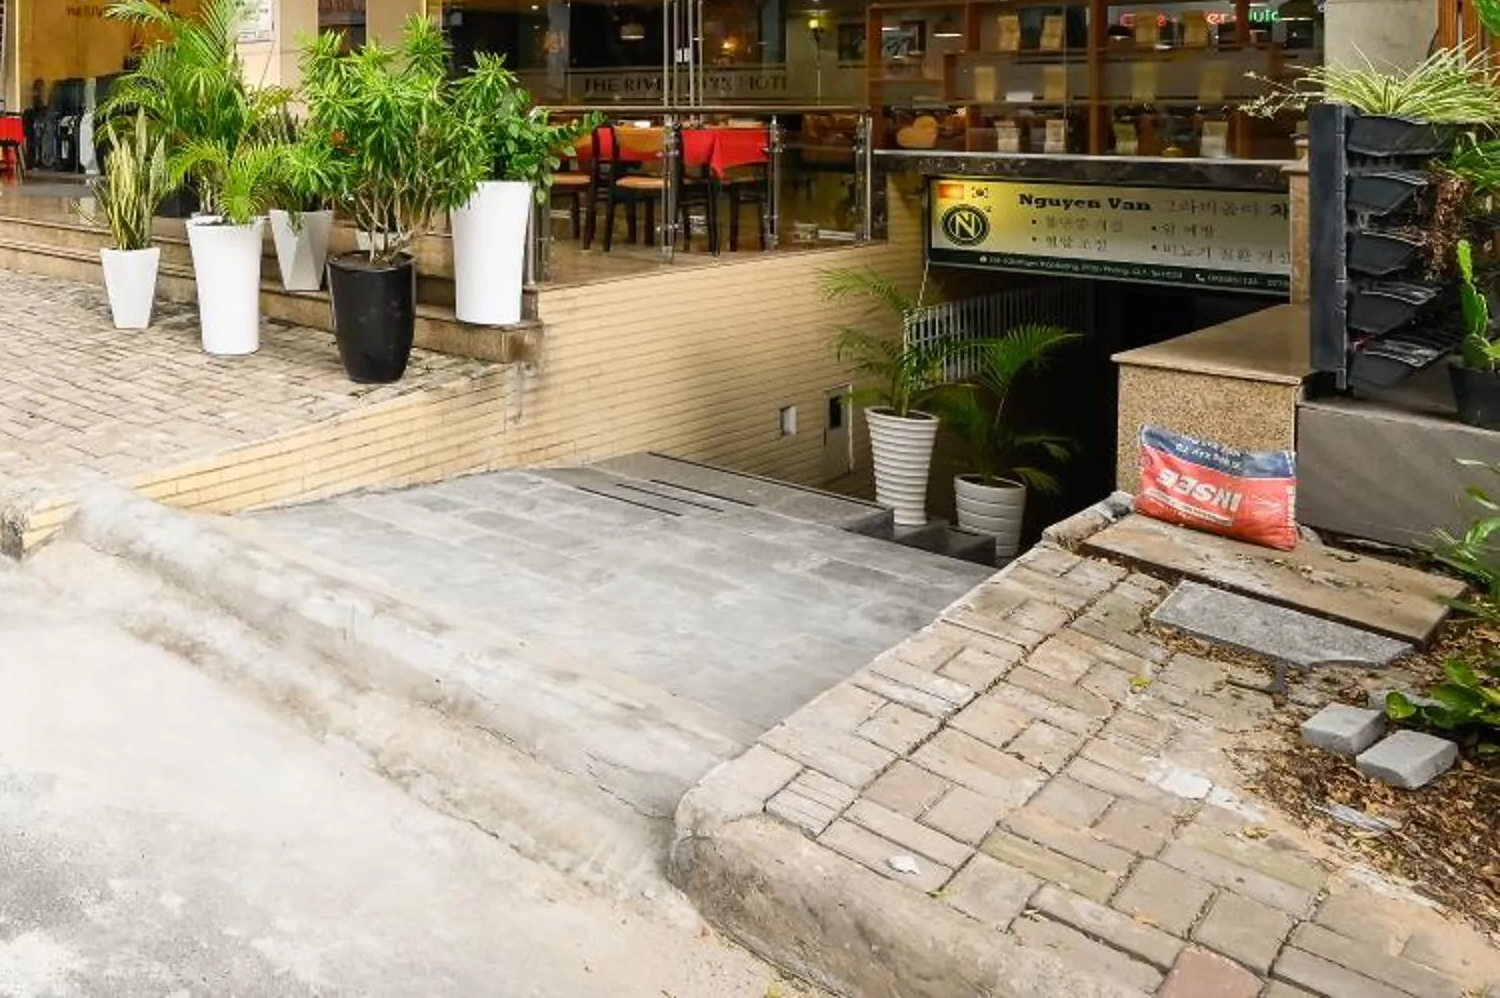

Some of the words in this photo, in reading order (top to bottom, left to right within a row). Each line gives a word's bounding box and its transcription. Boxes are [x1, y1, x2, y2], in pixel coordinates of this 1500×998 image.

[584, 78, 618, 92] THE
[1019, 193, 1102, 211] Nguyen
[1108, 197, 1152, 211] Van
[1156, 467, 1243, 513] INSEE
